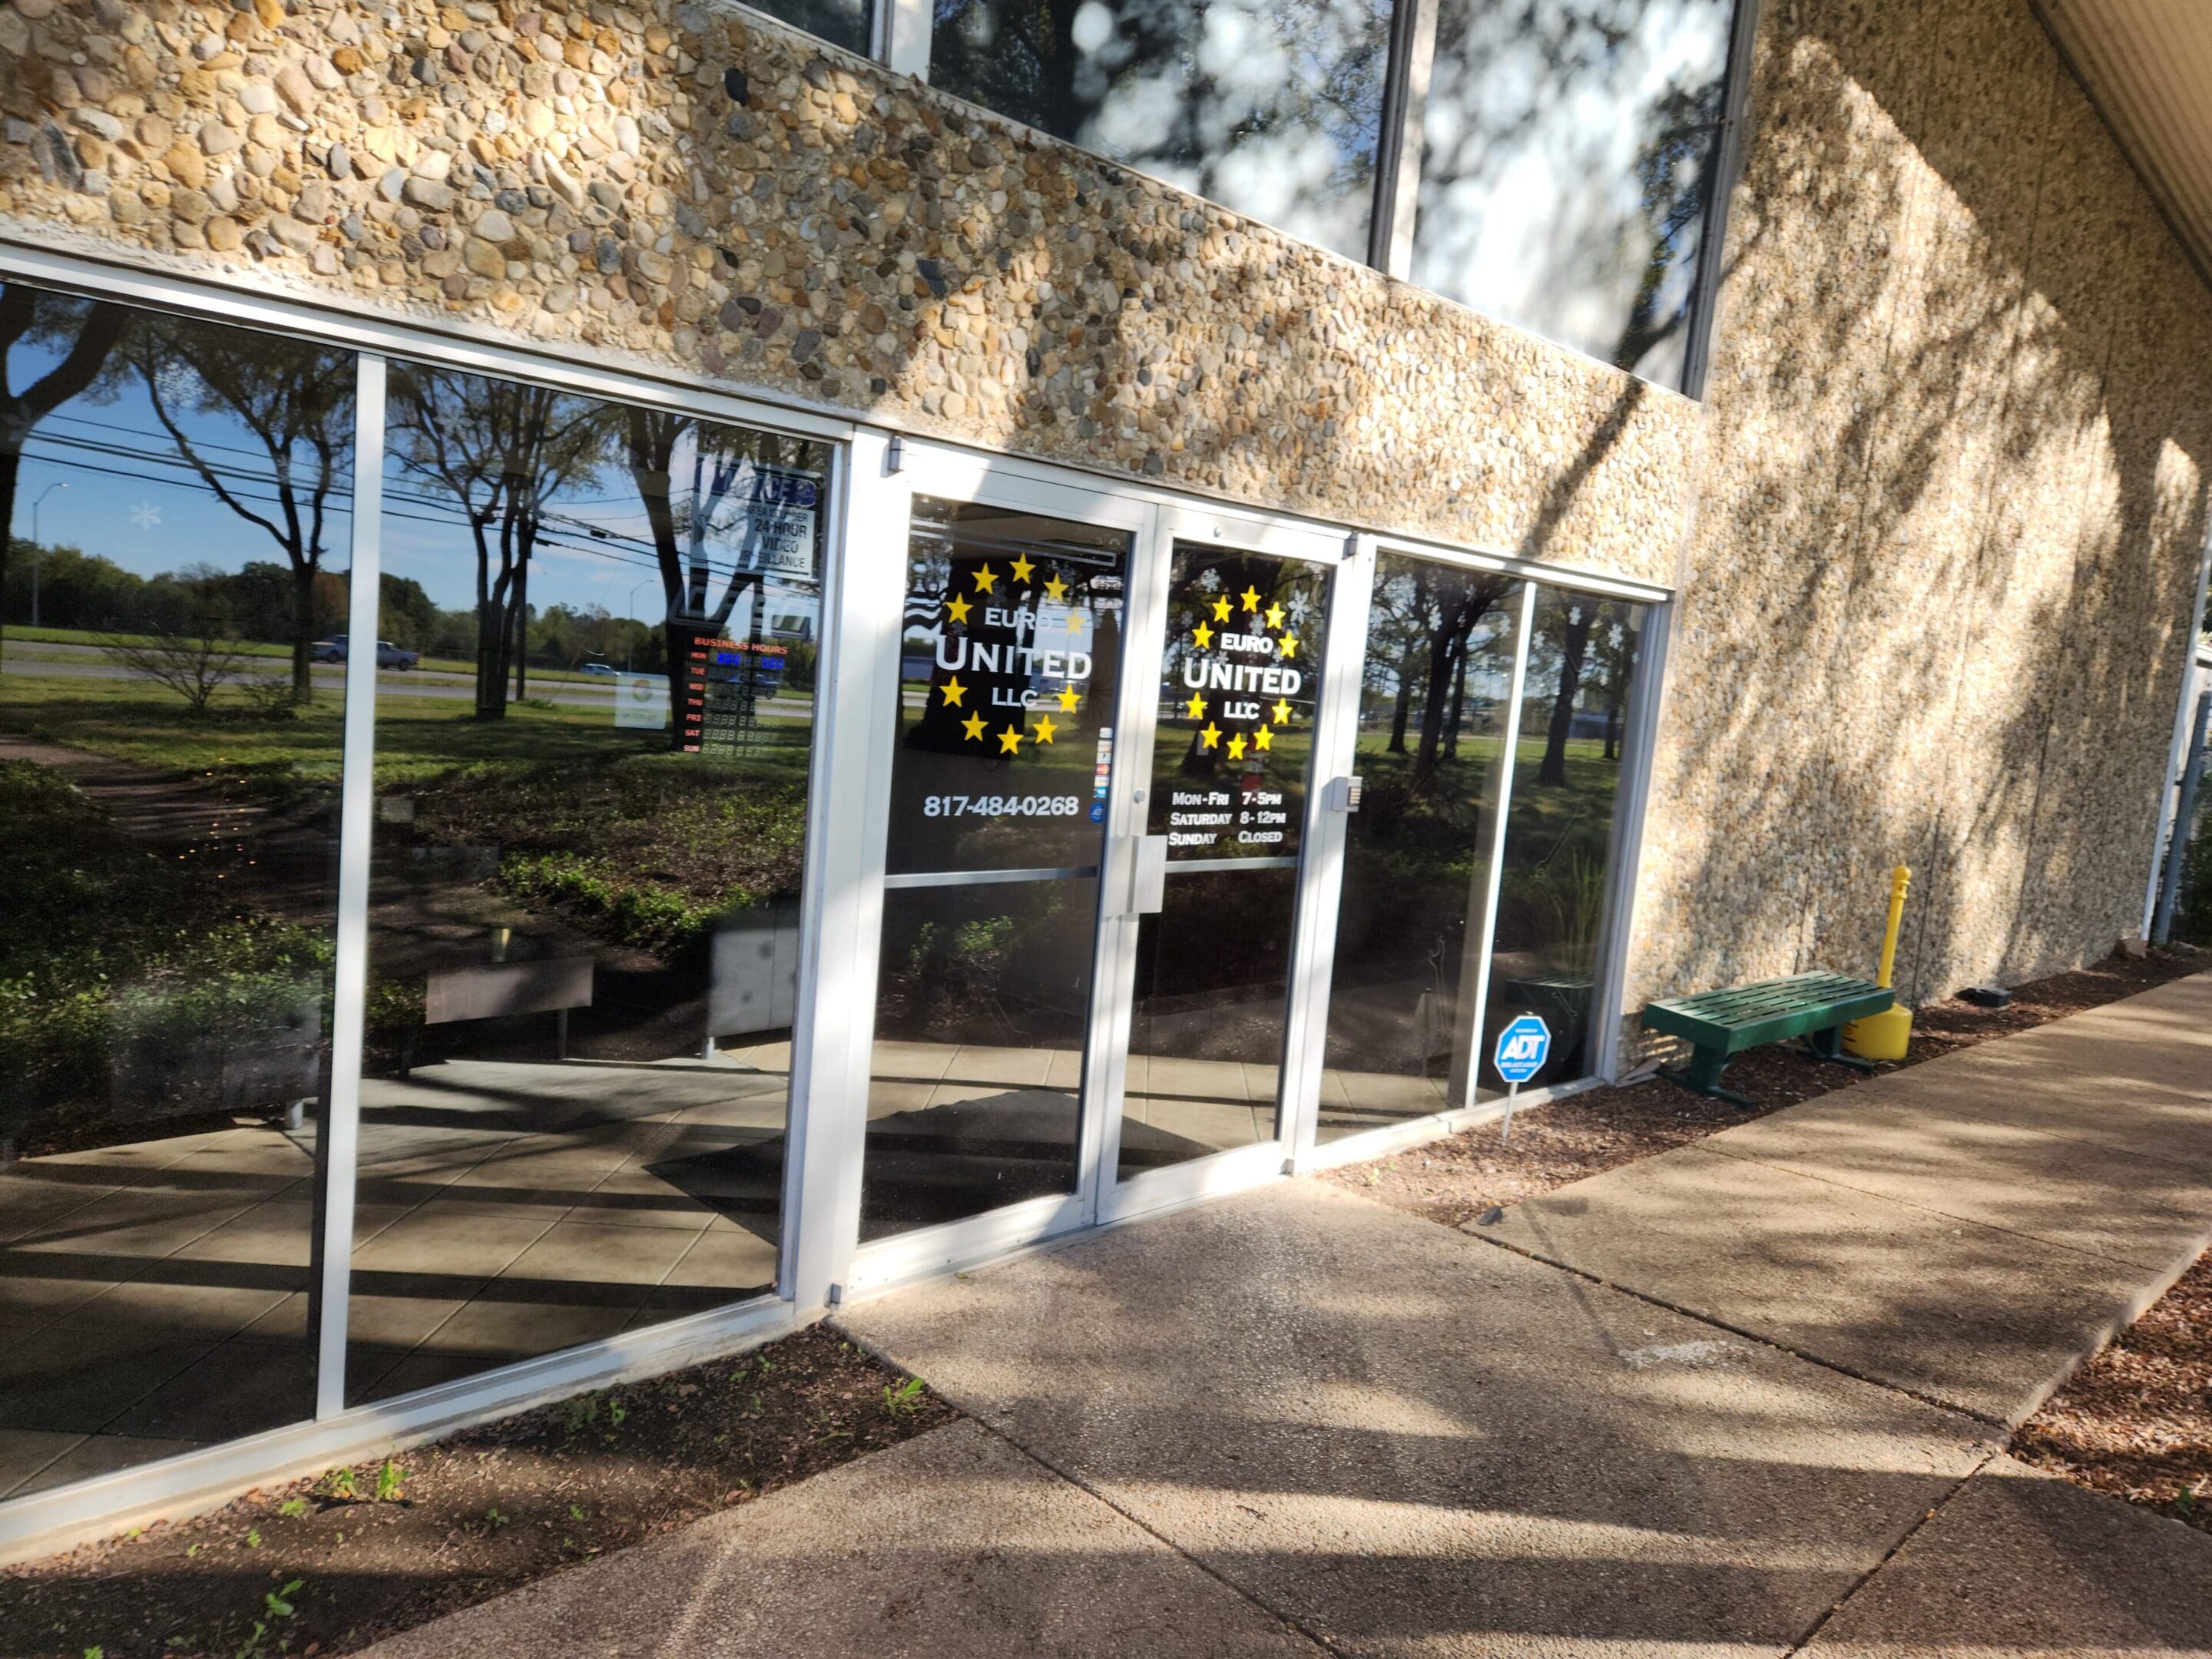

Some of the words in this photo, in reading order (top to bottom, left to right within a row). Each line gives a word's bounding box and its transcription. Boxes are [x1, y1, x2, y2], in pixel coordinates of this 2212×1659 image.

[755, 518, 770, 532] 24
[773, 522, 806, 538] HOUR
[762, 536, 799, 553] VIDEO
[740, 549, 806, 568] UREILLANCE
[985, 607, 1053, 631] EURO
[694, 637, 749, 651] BUSINESS
[751, 644, 788, 654] HOURS
[1220, 632, 1273, 653] EURO
[935, 634, 1092, 679] UNITED
[1184, 657, 1301, 694] UNITED
[992, 687, 1038, 707] LLC
[1224, 700, 1260, 720] LLC
[923, 796, 1079, 816] 817-484-0268
[1170, 812, 1233, 825] SATURDAY
[1168, 832, 1217, 846] SUNDAY
[1238, 830, 1283, 843] CLOSED
[1500, 1035, 1546, 1060] ADT
